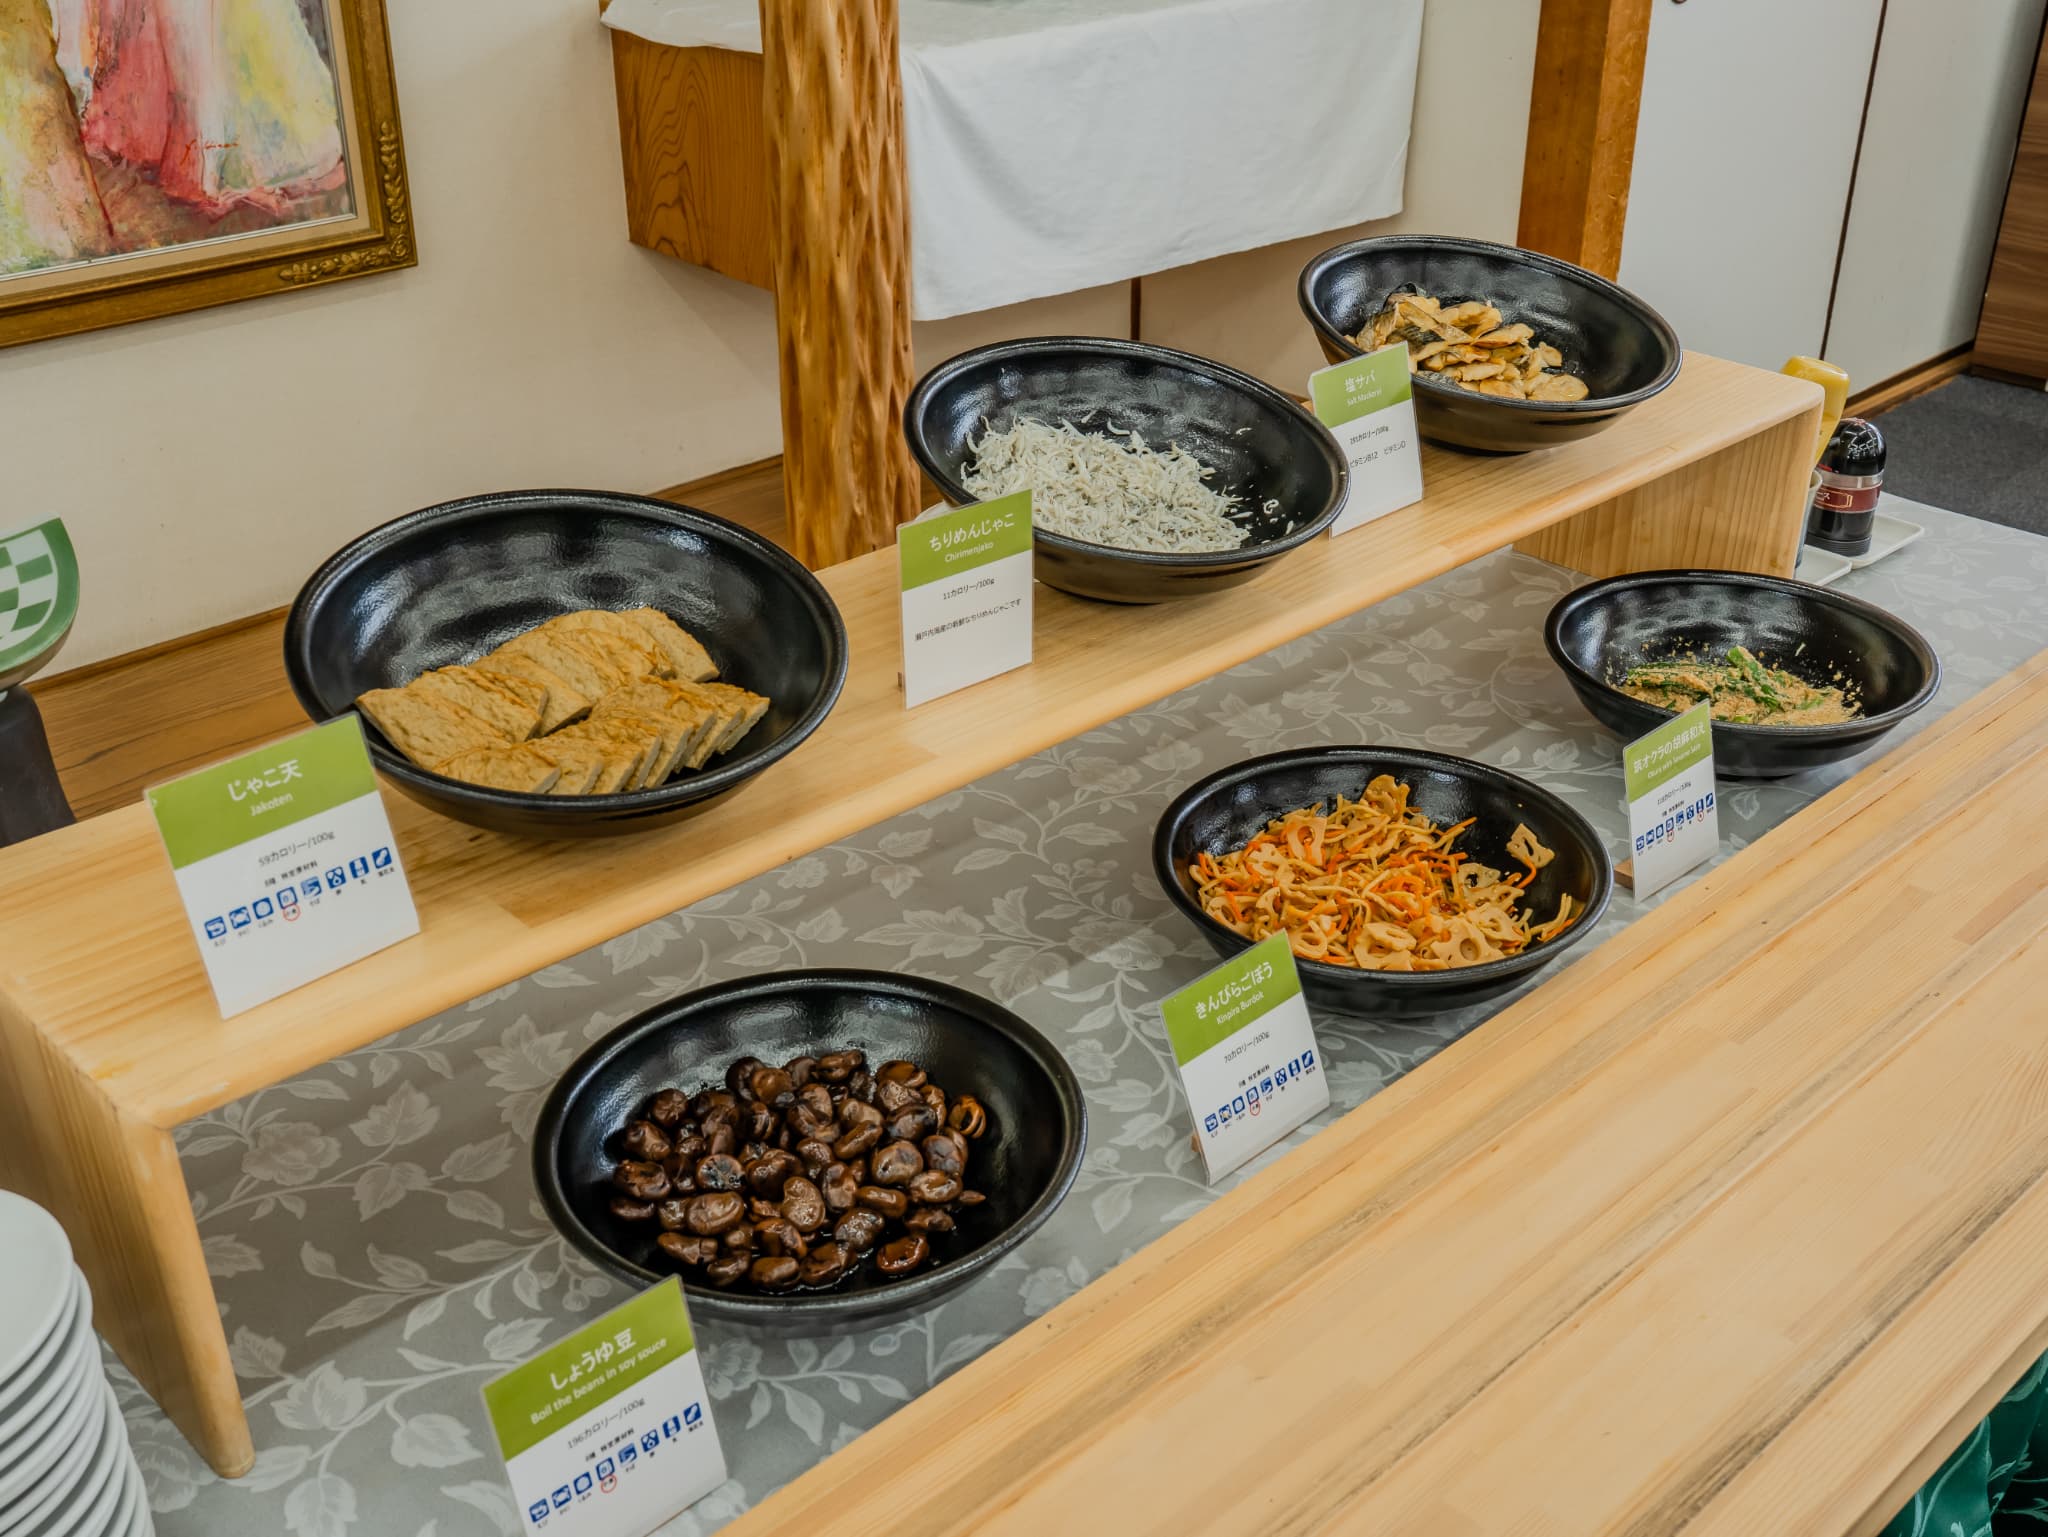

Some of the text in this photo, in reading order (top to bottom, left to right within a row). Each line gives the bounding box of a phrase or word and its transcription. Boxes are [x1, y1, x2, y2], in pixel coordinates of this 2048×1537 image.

[1345, 369, 1375, 392] 塩サバ
[929, 512, 1015, 552] ちりめんじゃこ
[943, 578, 995, 600] 11カロリー/100g
[227, 758, 303, 802] じゃこ天
[250, 793, 294, 816] Jakoten
[258, 831, 335, 868] 59カロリー/100g
[1195, 961, 1273, 1019] きんぴらごぼう
[1216, 1006, 1240, 1025] Kinpira
[550, 1327, 637, 1390] しょうゆ豆
[530, 1404, 553, 1424] Boil
[553, 1395, 572, 1411] the
[573, 1375, 606, 1399] beans
[606, 1368, 617, 1380] in
[619, 1356, 636, 1373] soy
[567, 1398, 646, 1449] 196カロリー/100g
